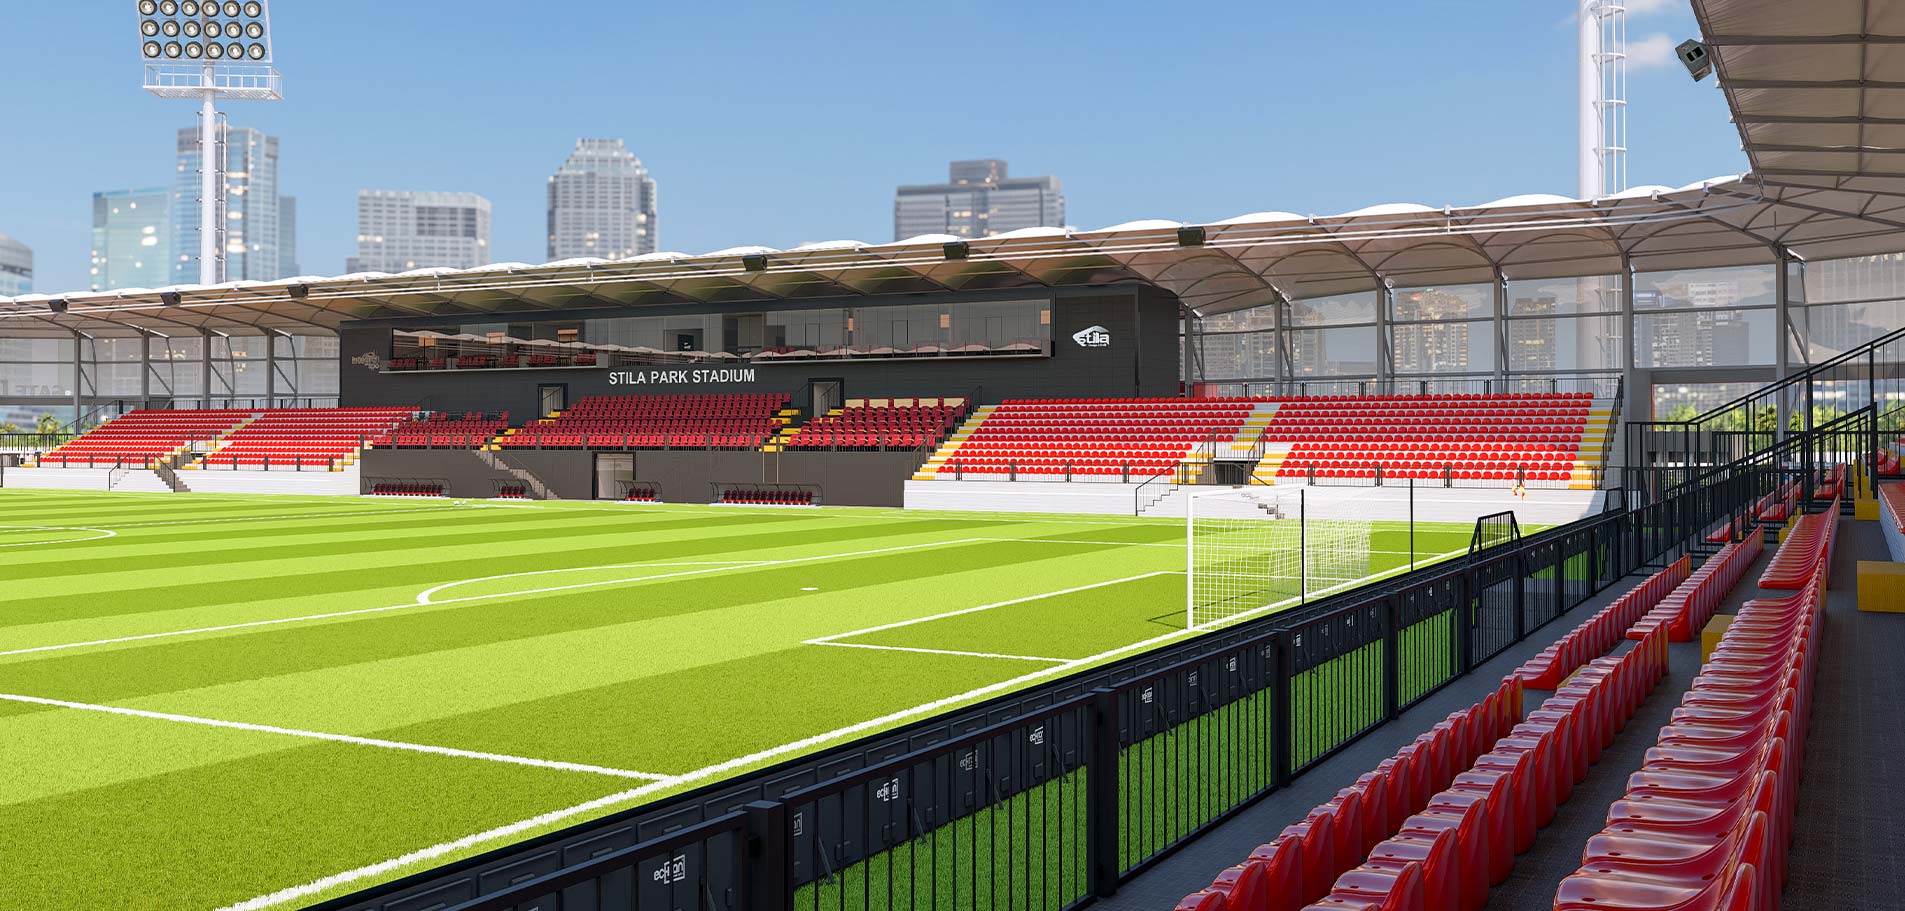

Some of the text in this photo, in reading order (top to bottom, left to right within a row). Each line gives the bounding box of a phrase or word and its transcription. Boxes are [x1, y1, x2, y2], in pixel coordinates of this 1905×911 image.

[609, 369, 755, 385] STILA PARK STADIUM
